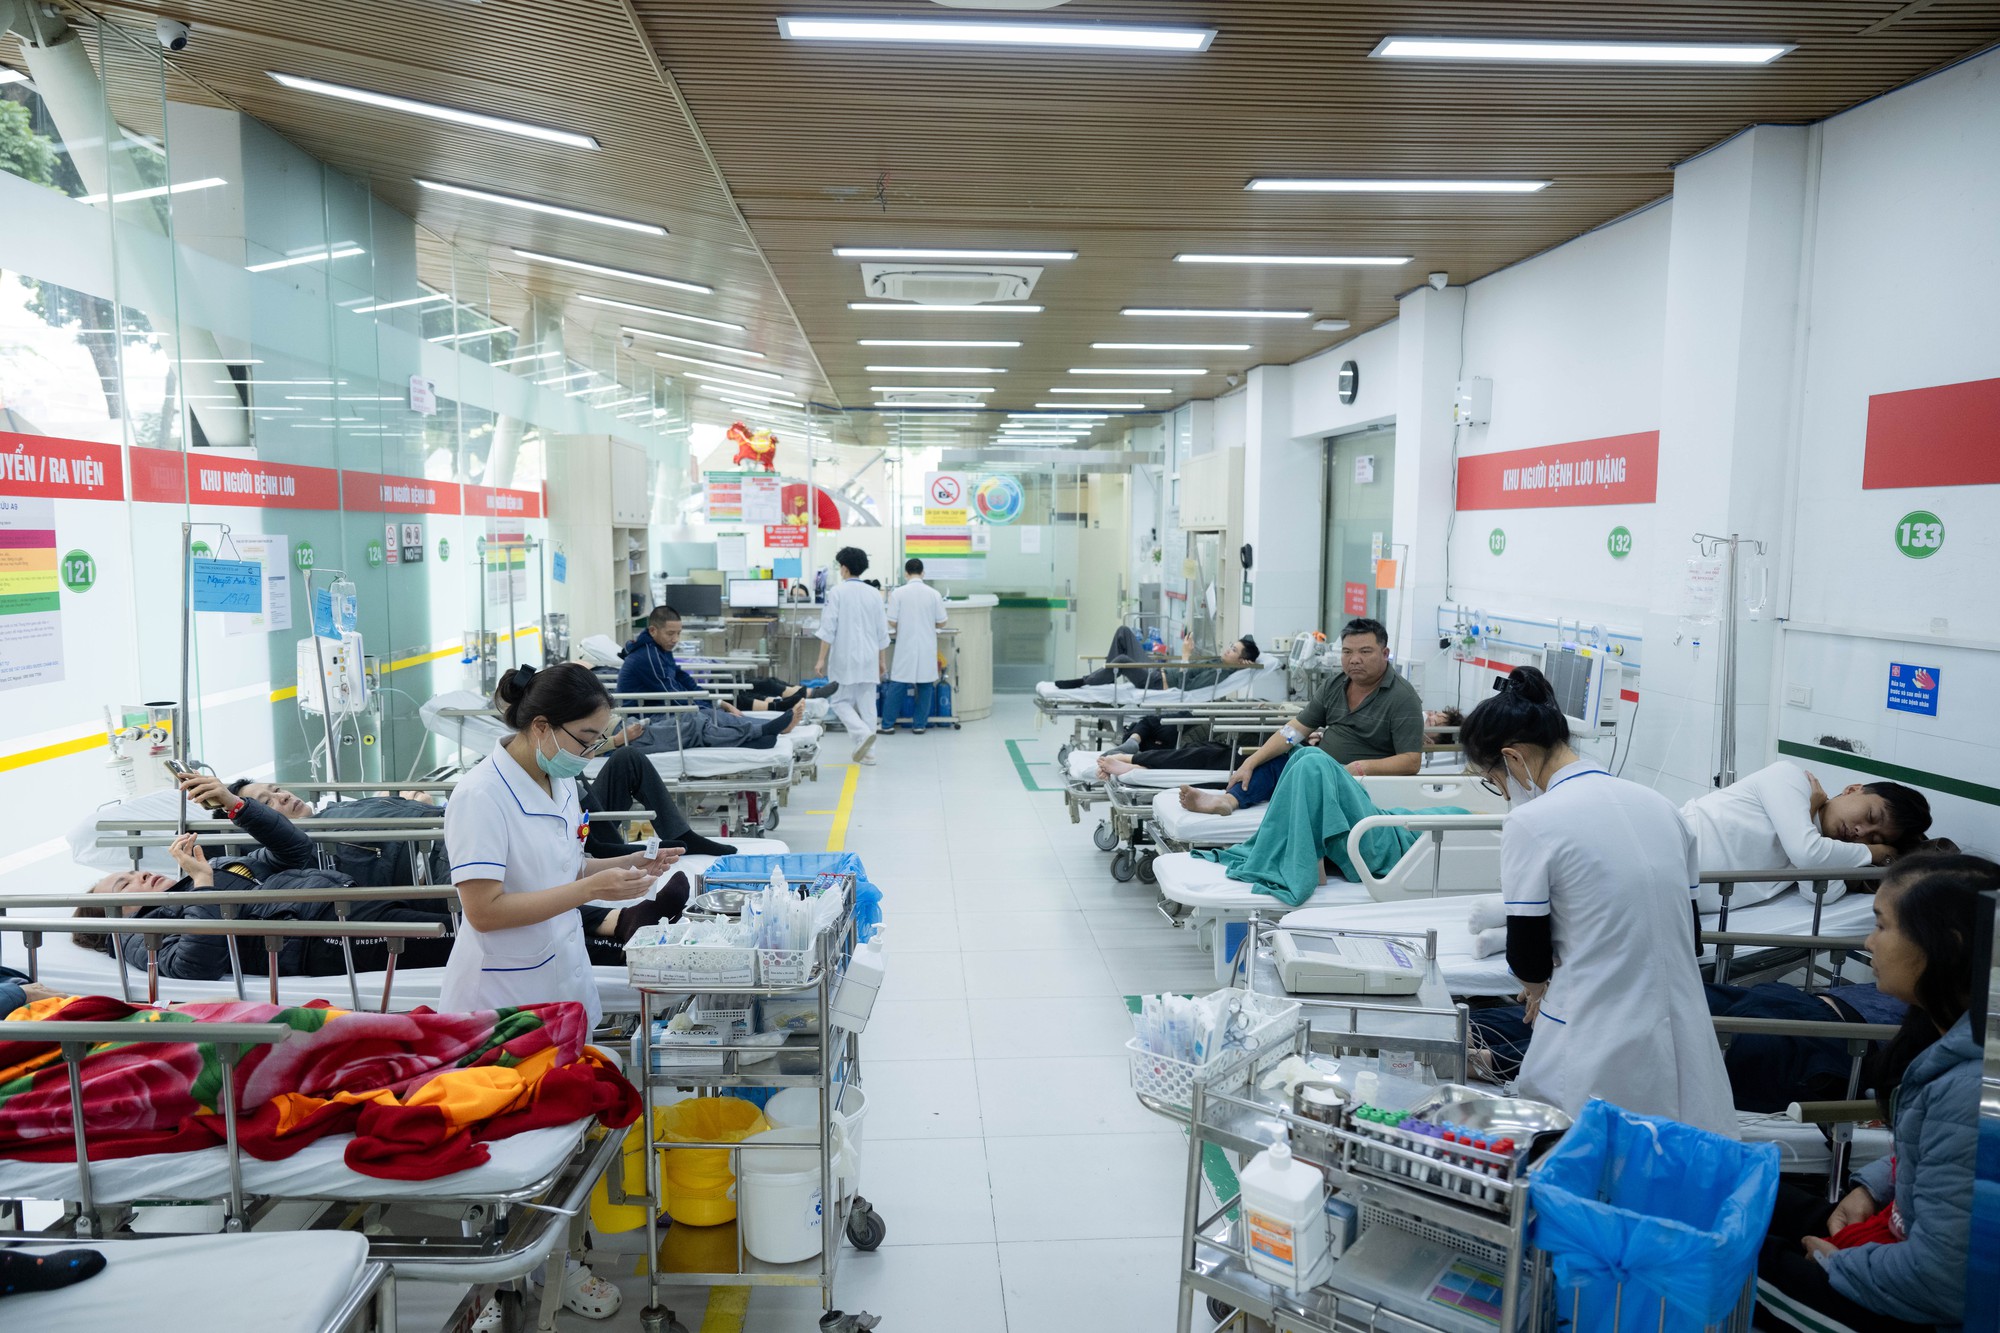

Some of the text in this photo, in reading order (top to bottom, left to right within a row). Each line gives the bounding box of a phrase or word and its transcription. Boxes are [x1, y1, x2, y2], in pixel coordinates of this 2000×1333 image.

[39, 456, 46, 483] /
[48, 457, 70, 484] RA
[71, 455, 104, 491] VIỆN
[1503, 453, 1627, 493] KHU NGƯỜI BỆNH LƯU NẶNG
[200, 469, 221, 491] KHU
[223, 468, 252, 494] NGƯỜI
[254, 470, 278, 499] BỆNH
[279, 475, 295, 496] LƯU
[1490, 535, 1505, 550] 131
[1610, 534, 1630, 552] 132
[1900, 522, 1942, 548] 133
[297, 548, 314, 565] 123
[368, 546, 382, 561] 124
[405, 548, 414, 560] NO
[64, 560, 93, 583] 121
